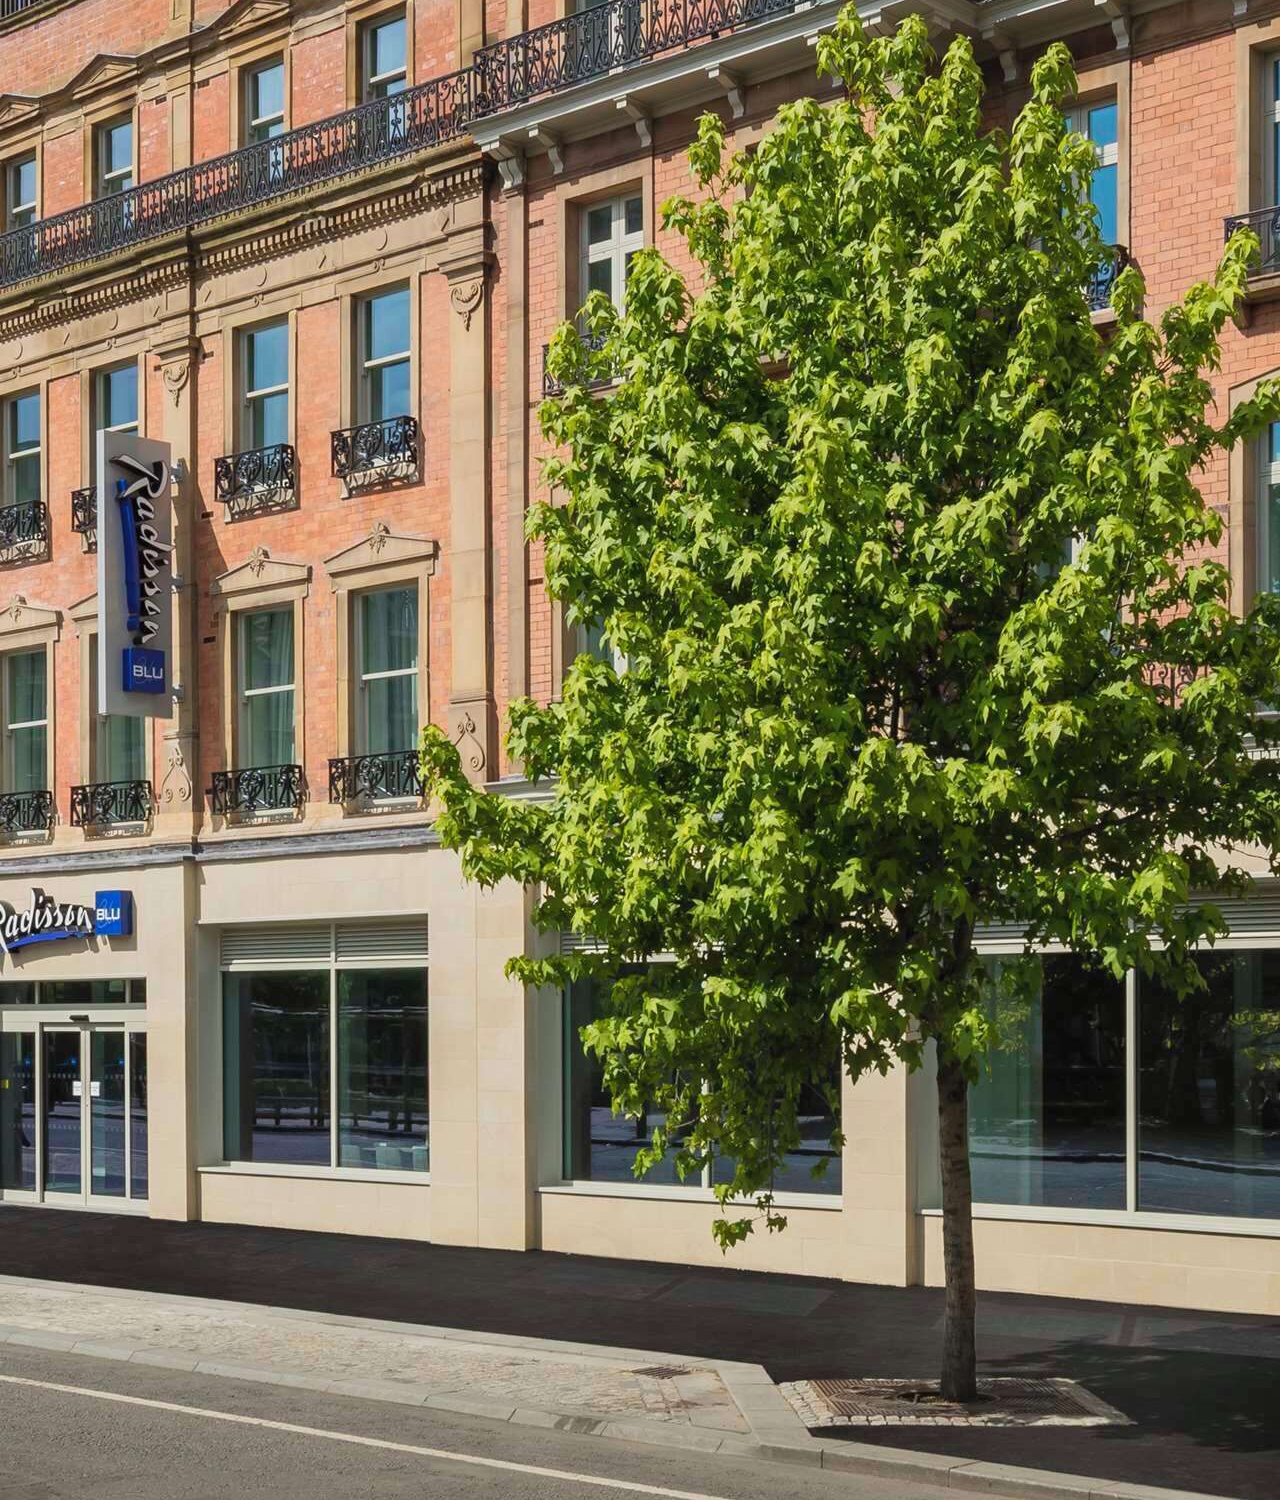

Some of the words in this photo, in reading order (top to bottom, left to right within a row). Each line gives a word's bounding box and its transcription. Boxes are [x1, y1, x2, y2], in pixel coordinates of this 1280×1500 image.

[114, 454, 175, 645] Radisson
[133, 664, 163, 680] BLU
[96, 908, 121, 921] BLU
